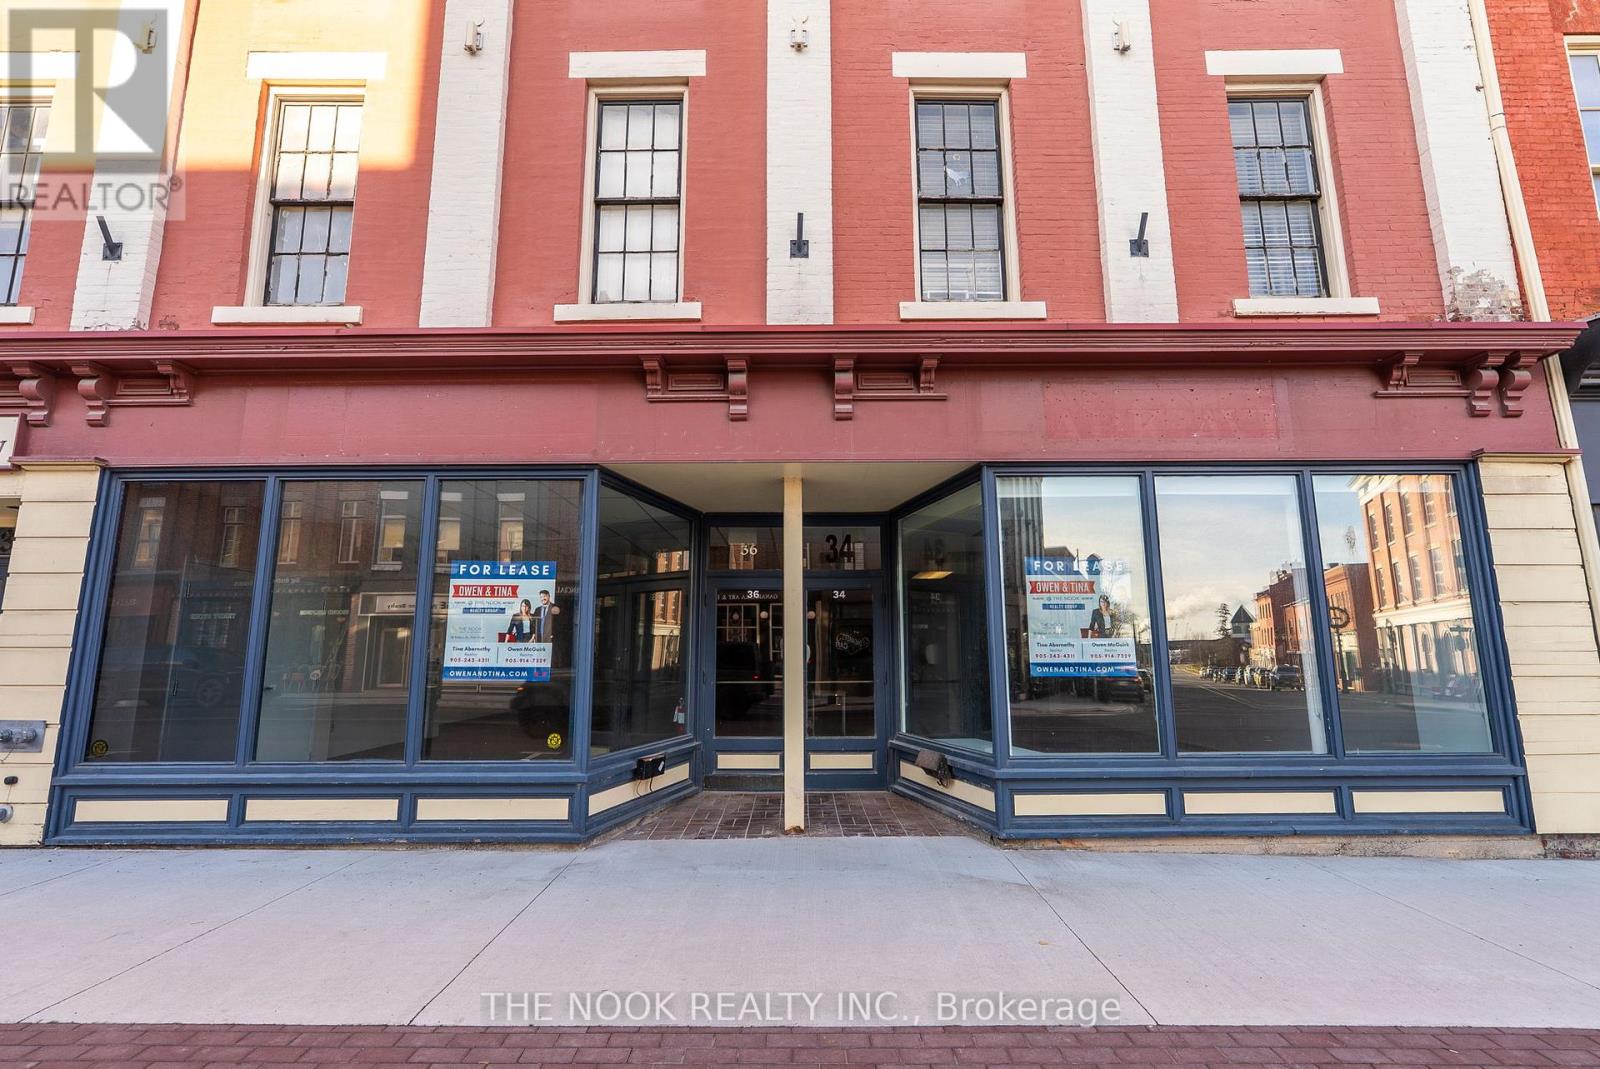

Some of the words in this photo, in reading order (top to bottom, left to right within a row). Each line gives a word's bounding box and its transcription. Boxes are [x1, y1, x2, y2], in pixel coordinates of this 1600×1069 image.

[740, 544, 758, 555] 36
[825, 534, 856, 563] 34
[460, 565, 491, 575] FOR
[500, 565, 550, 575] LEASE
[1034, 561, 1064, 571] FOR
[1073, 560, 1123, 571] LEASE
[459, 586, 483, 596] OWEN
[485, 586, 492, 596] &
[493, 586, 513, 596] TINA
[1036, 582, 1061, 593] OWEN
[1062, 582, 1069, 593] &
[1070, 582, 1089, 593] TINA
[747, 590, 760, 599] 36
[832, 590, 846, 599] 34
